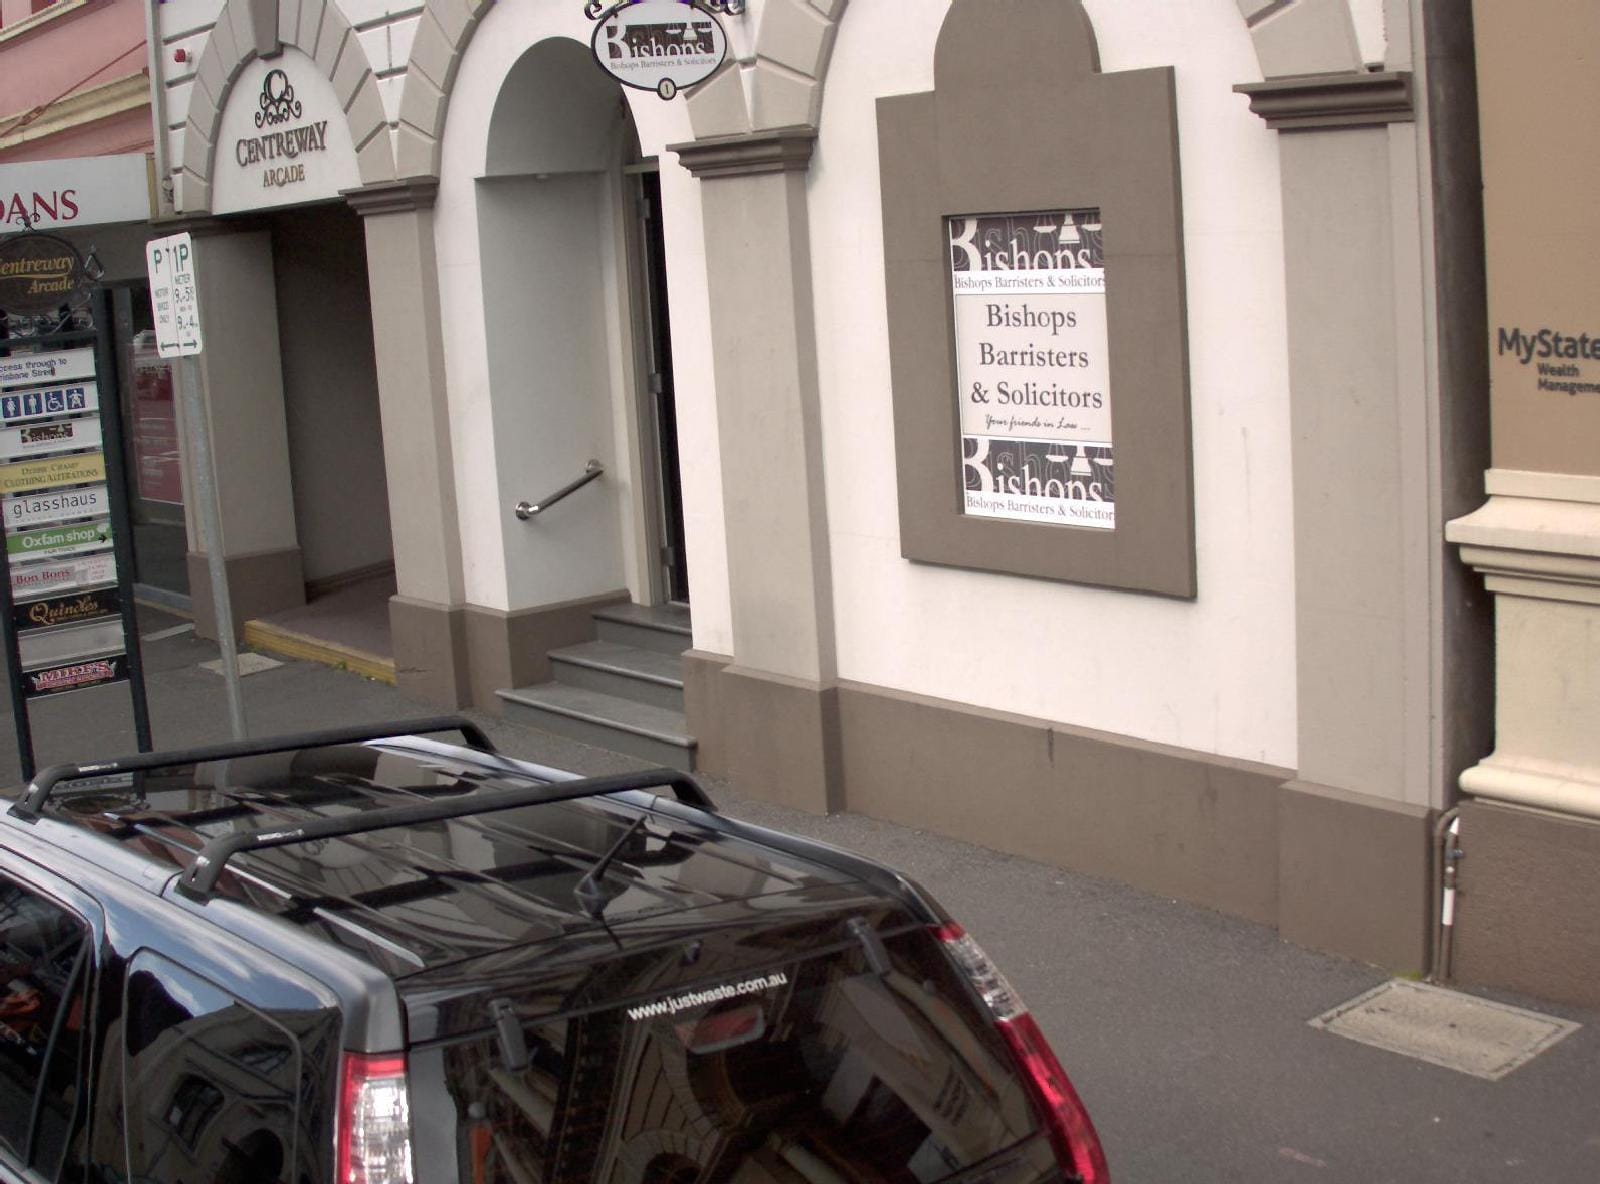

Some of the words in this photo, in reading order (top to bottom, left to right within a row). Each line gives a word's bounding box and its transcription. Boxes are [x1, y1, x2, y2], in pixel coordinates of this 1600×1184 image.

[236, 120, 327, 167] CENTREWAY
[263, 164, 305, 187] ARCADE
[0, 257, 74, 275] entreway
[153, 249, 163, 274] P
[173, 243, 189, 273] 1P
[28, 276, 74, 294] Arcade
[954, 276, 992, 291] Bishops
[995, 276, 1044, 289] Barristers
[1047, 276, 1056, 287] &
[986, 304, 1077, 336] Bishops
[978, 342, 1089, 368] Barristers
[1498, 327, 1600, 365] MyState
[0, 363, 22, 372] ccess
[26, 358, 57, 369] through
[0, 372, 28, 380] risbane
[31, 367, 55, 377] Stree
[1537, 362, 1580, 377] Wealth
[970, 381, 990, 404] &
[997, 381, 1103, 409] Solicitors
[1537, 378, 1600, 396] Manageme
[985, 413, 1008, 430] Your
[1009, 415, 1041, 431] friends
[1043, 419, 1054, 428] in
[1057, 416, 1078, 429] Law
[13, 493, 97, 518] glasshaus
[966, 495, 1005, 511] Bishops
[1007, 498, 1055, 515] Barristers
[1058, 504, 1067, 516] &
[1069, 507, 1115, 521] Solicitor
[22, 533, 65, 548] Oxfam
[66, 529, 95, 541] shop
[16, 574, 39, 585] Bon
[627, 972, 788, 1021] www.justwaste.com.au
